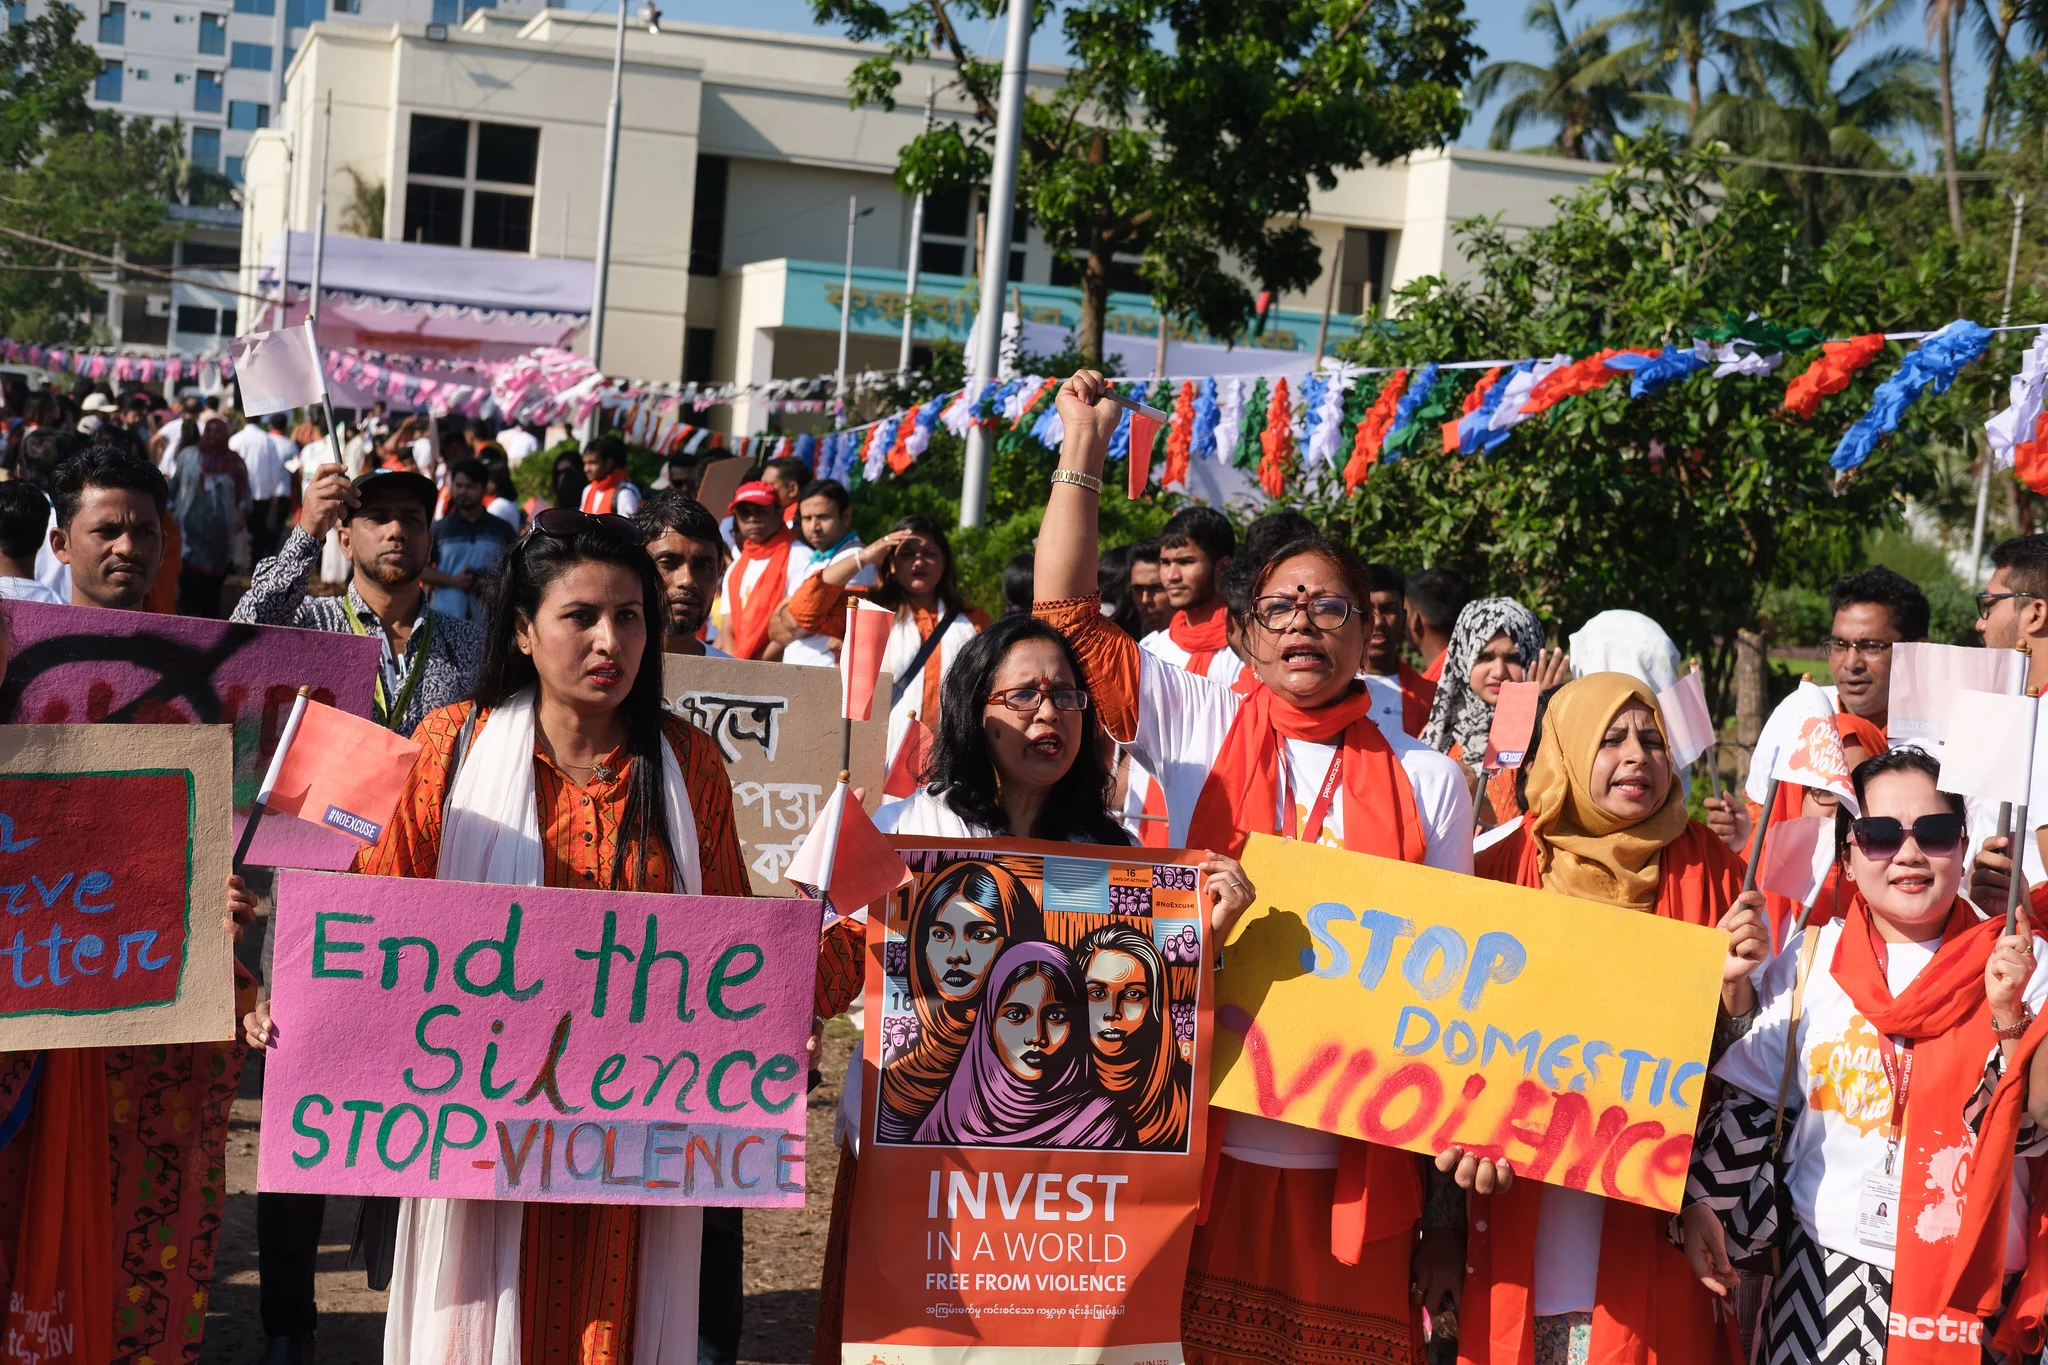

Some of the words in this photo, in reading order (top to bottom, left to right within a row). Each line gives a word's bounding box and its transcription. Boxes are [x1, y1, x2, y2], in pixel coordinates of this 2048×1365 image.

[328, 809, 377, 838] #NOEXCUSE
[1126, 869, 1136, 877] 16
[1155, 901, 1195, 909] #NoExcuse
[0, 922, 172, 988] tter
[312, 902, 543, 1001] End
[575, 910, 769, 1023] the
[1300, 902, 1527, 1012] STOP
[404, 1004, 801, 1115] Silence
[1393, 1005, 1706, 1109] DOMESTIC
[927, 1170, 1129, 1222] INVEST
[926, 1231, 961, 1261] IN
[972, 1232, 995, 1261] A
[1003, 1232, 1127, 1263] WORLD
[926, 1273, 969, 1290] FREE
[975, 1274, 1031, 1291] FROM
[1035, 1275, 1127, 1292] VIOLENCE
